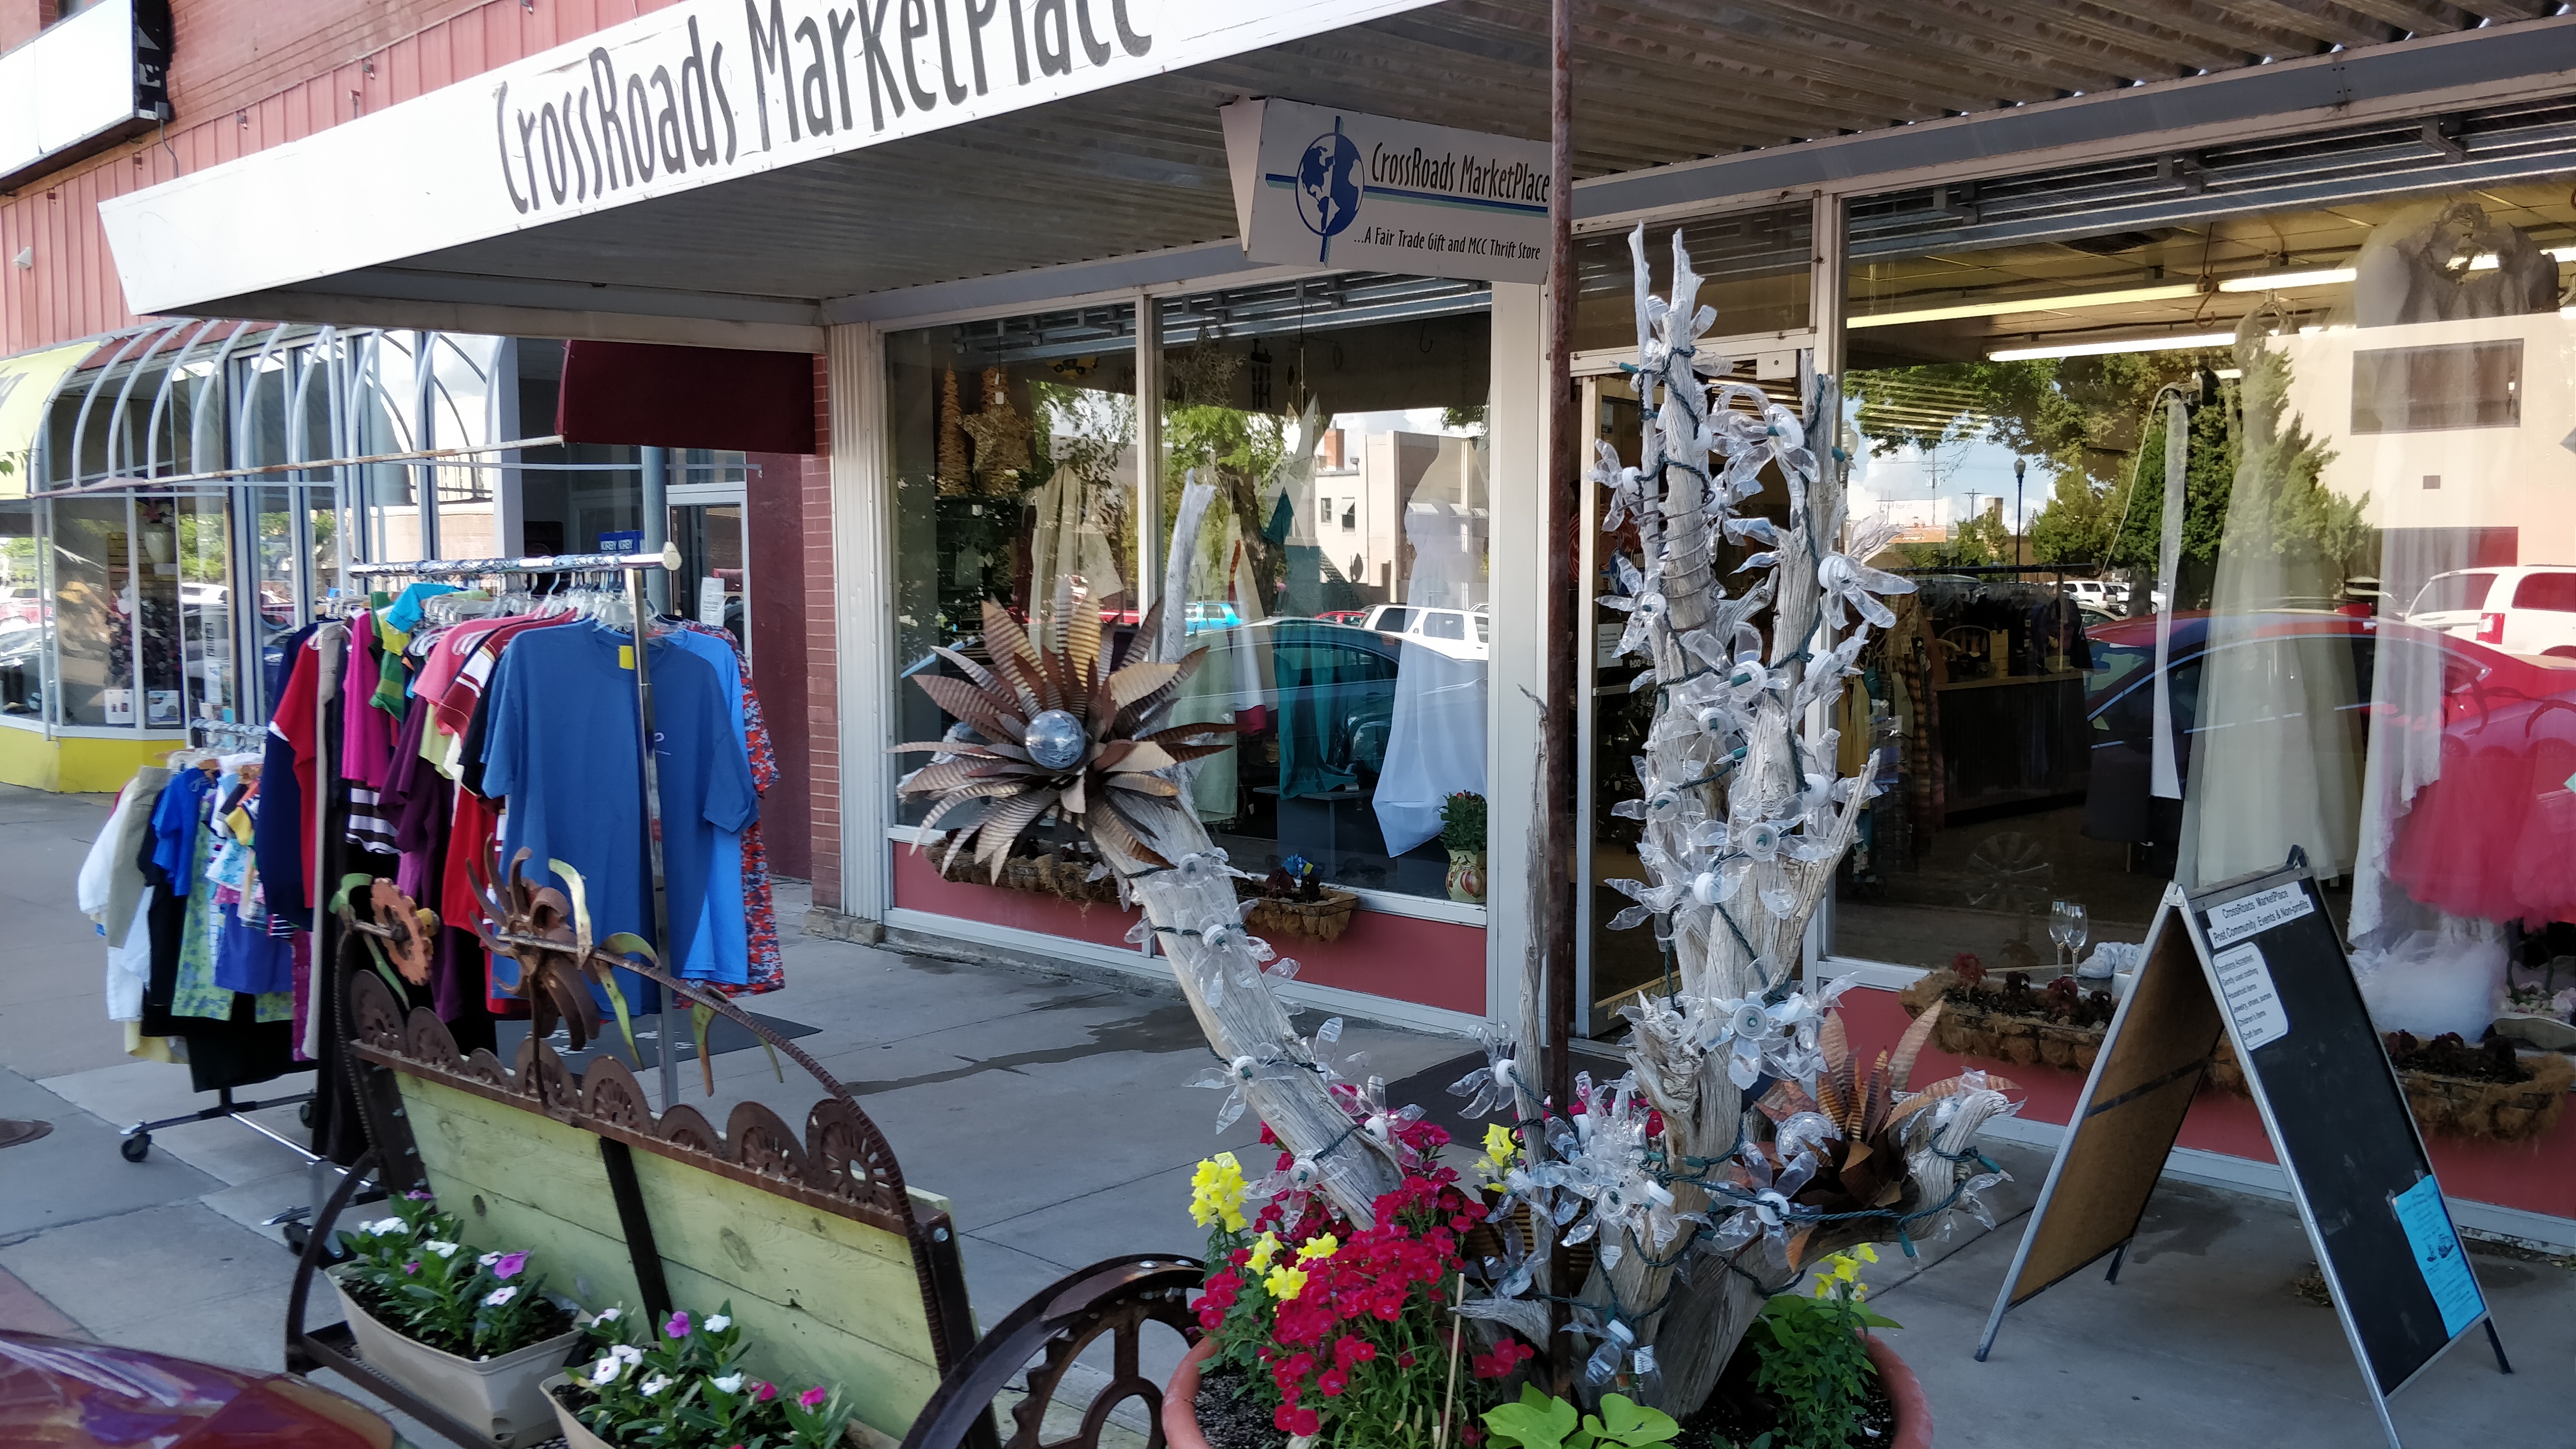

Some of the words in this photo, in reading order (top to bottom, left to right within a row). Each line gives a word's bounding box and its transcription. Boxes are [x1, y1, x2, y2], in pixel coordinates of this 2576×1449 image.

[493, 15, 737, 215] CrossRoads
[1371, 141, 1456, 192] CrossRoads
[1459, 154, 1550, 203] MarketPlace
[1375, 228, 1395, 247] Fair
[1398, 230, 1425, 249] Trade
[1428, 233, 1446, 253] Gift
[1448, 236, 1466, 253] and
[1468, 237, 1487, 255] MCC
[1490, 239, 1517, 259] Thrift
[1518, 241, 1541, 260] Store
[2213, 930, 2228, 943] Post
[2226, 920, 2257, 937] Community
[2257, 913, 2276, 926] Events
[2275, 910, 2281, 919] &
[2280, 899, 2310, 918] Non-profits
[2222, 900, 2256, 918] CrossRoads
[2255, 890, 2289, 907] MarketPlace
